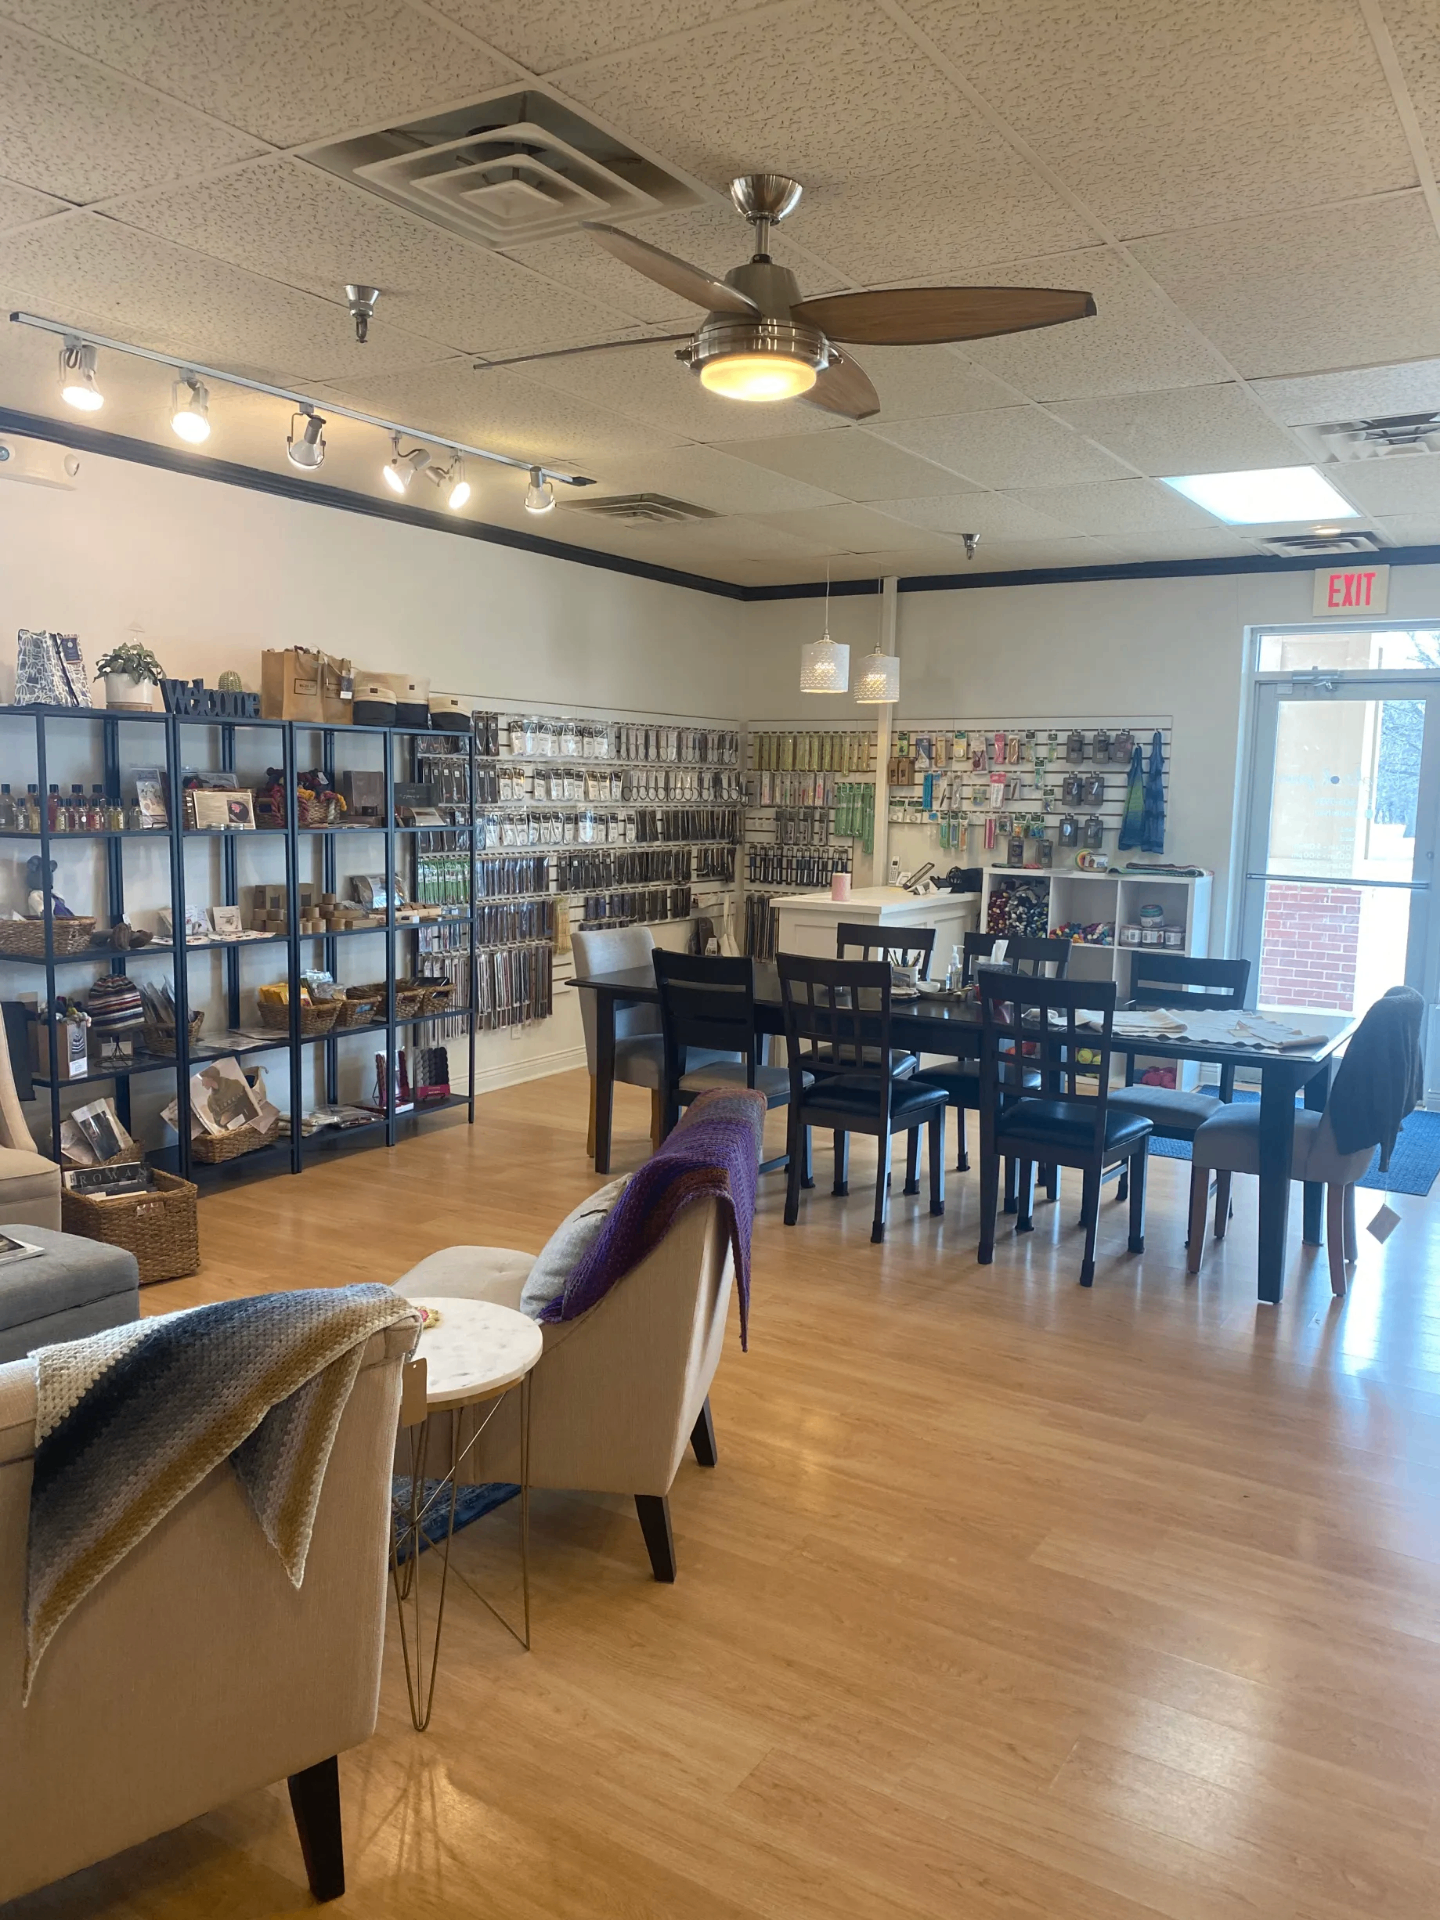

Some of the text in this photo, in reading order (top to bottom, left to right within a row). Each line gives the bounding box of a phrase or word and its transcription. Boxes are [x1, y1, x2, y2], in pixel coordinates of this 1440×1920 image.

[1328, 572, 1376, 607] EXIT
[158, 678, 260, 717] Welcome
[79, 1167, 147, 1185] ROWAN
